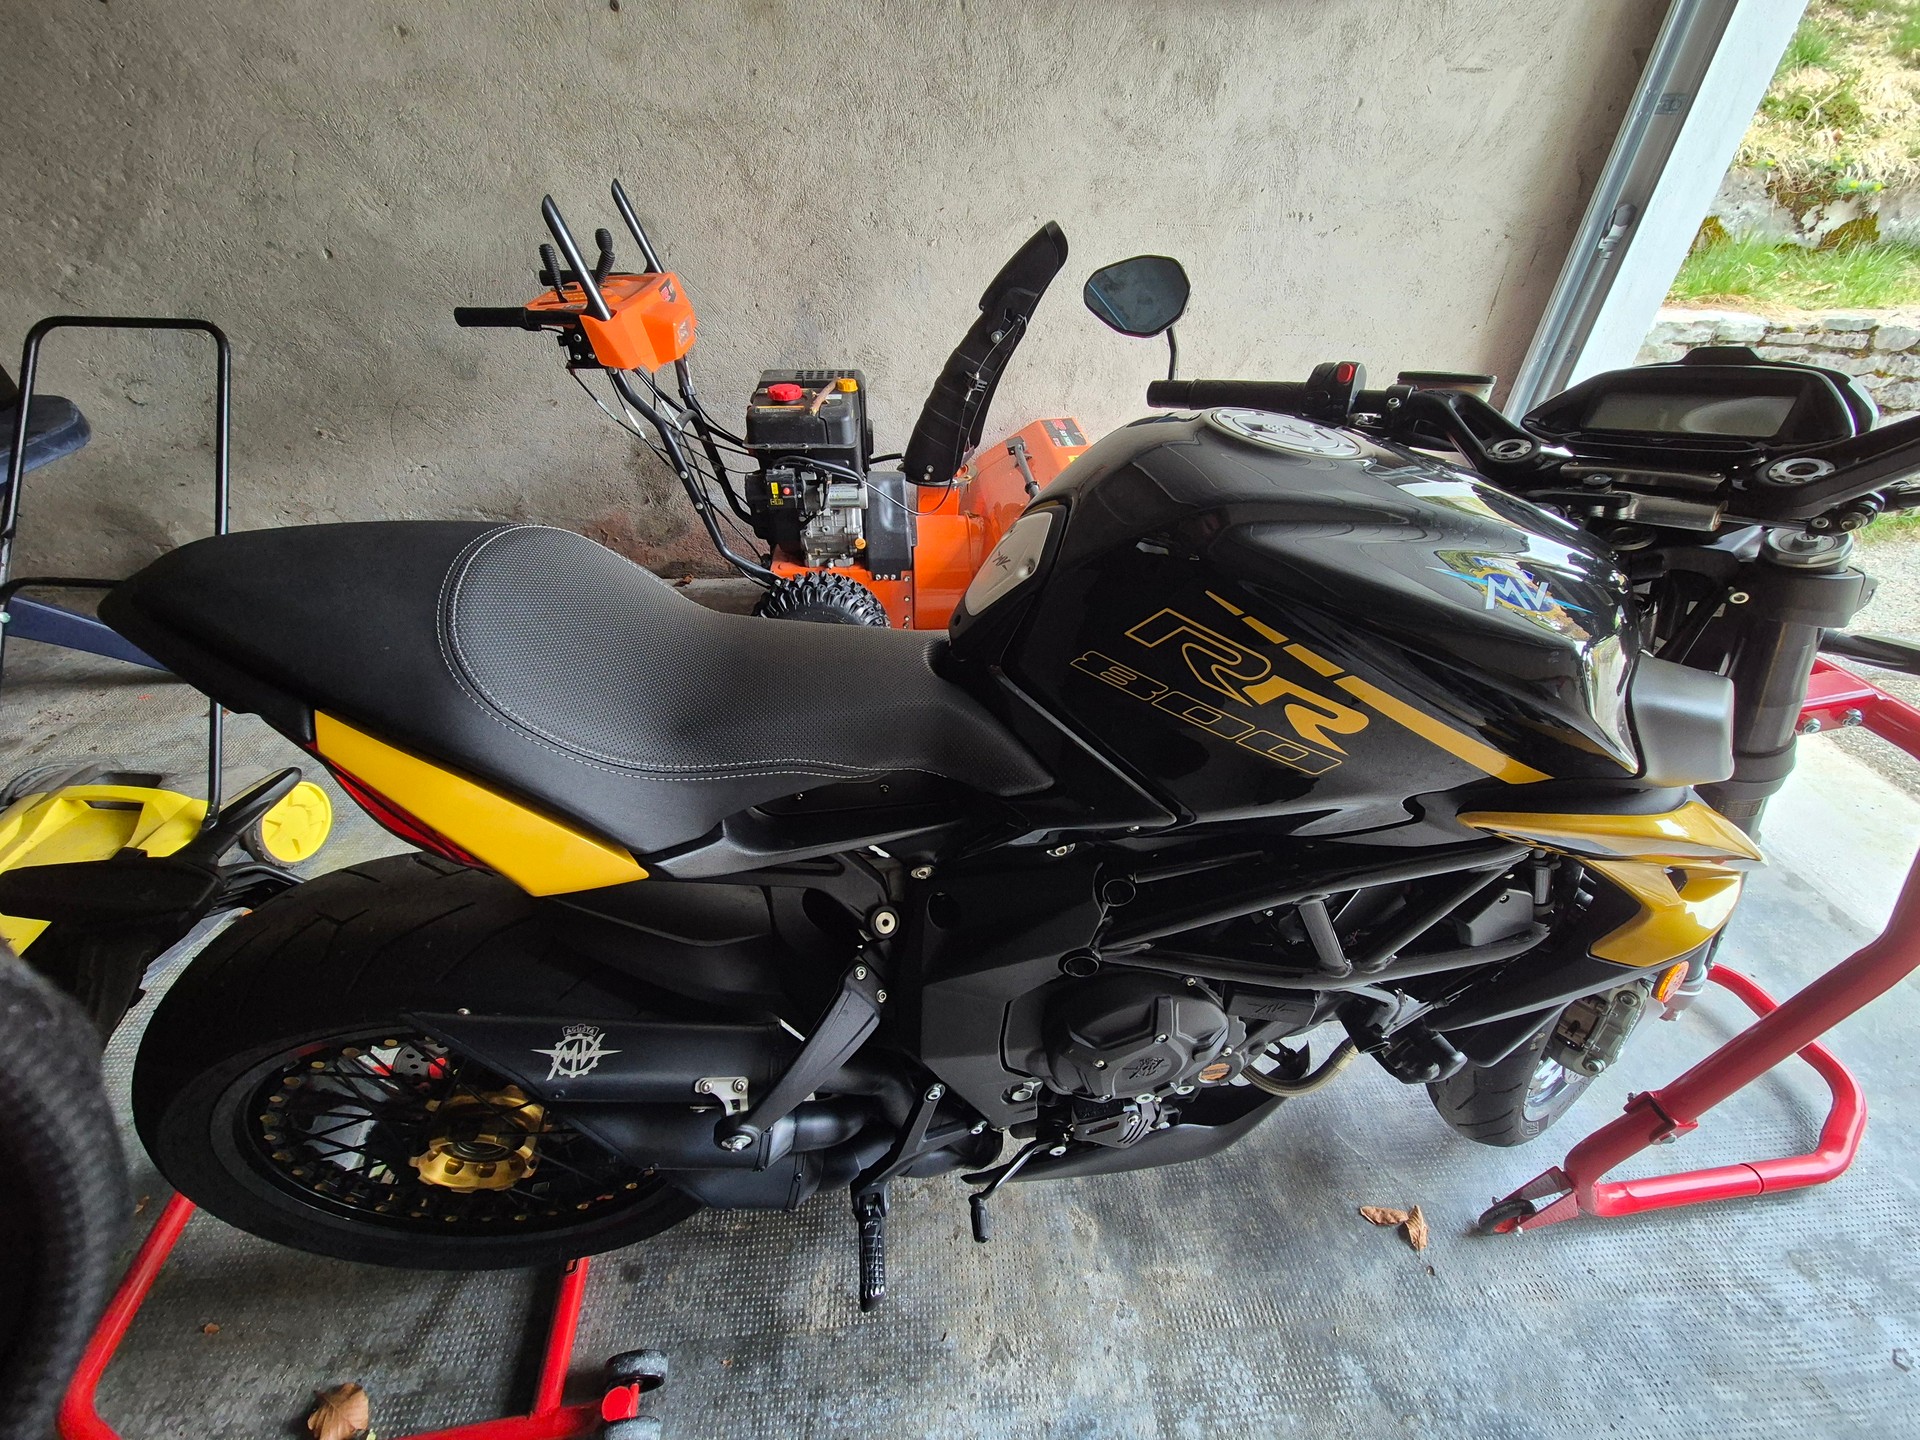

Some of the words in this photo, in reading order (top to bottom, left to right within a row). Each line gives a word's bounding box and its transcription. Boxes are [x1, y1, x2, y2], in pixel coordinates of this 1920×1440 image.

[1485, 576, 1549, 610] MV
[1124, 607, 1369, 756] RR
[546, 1033, 605, 1081] MV
